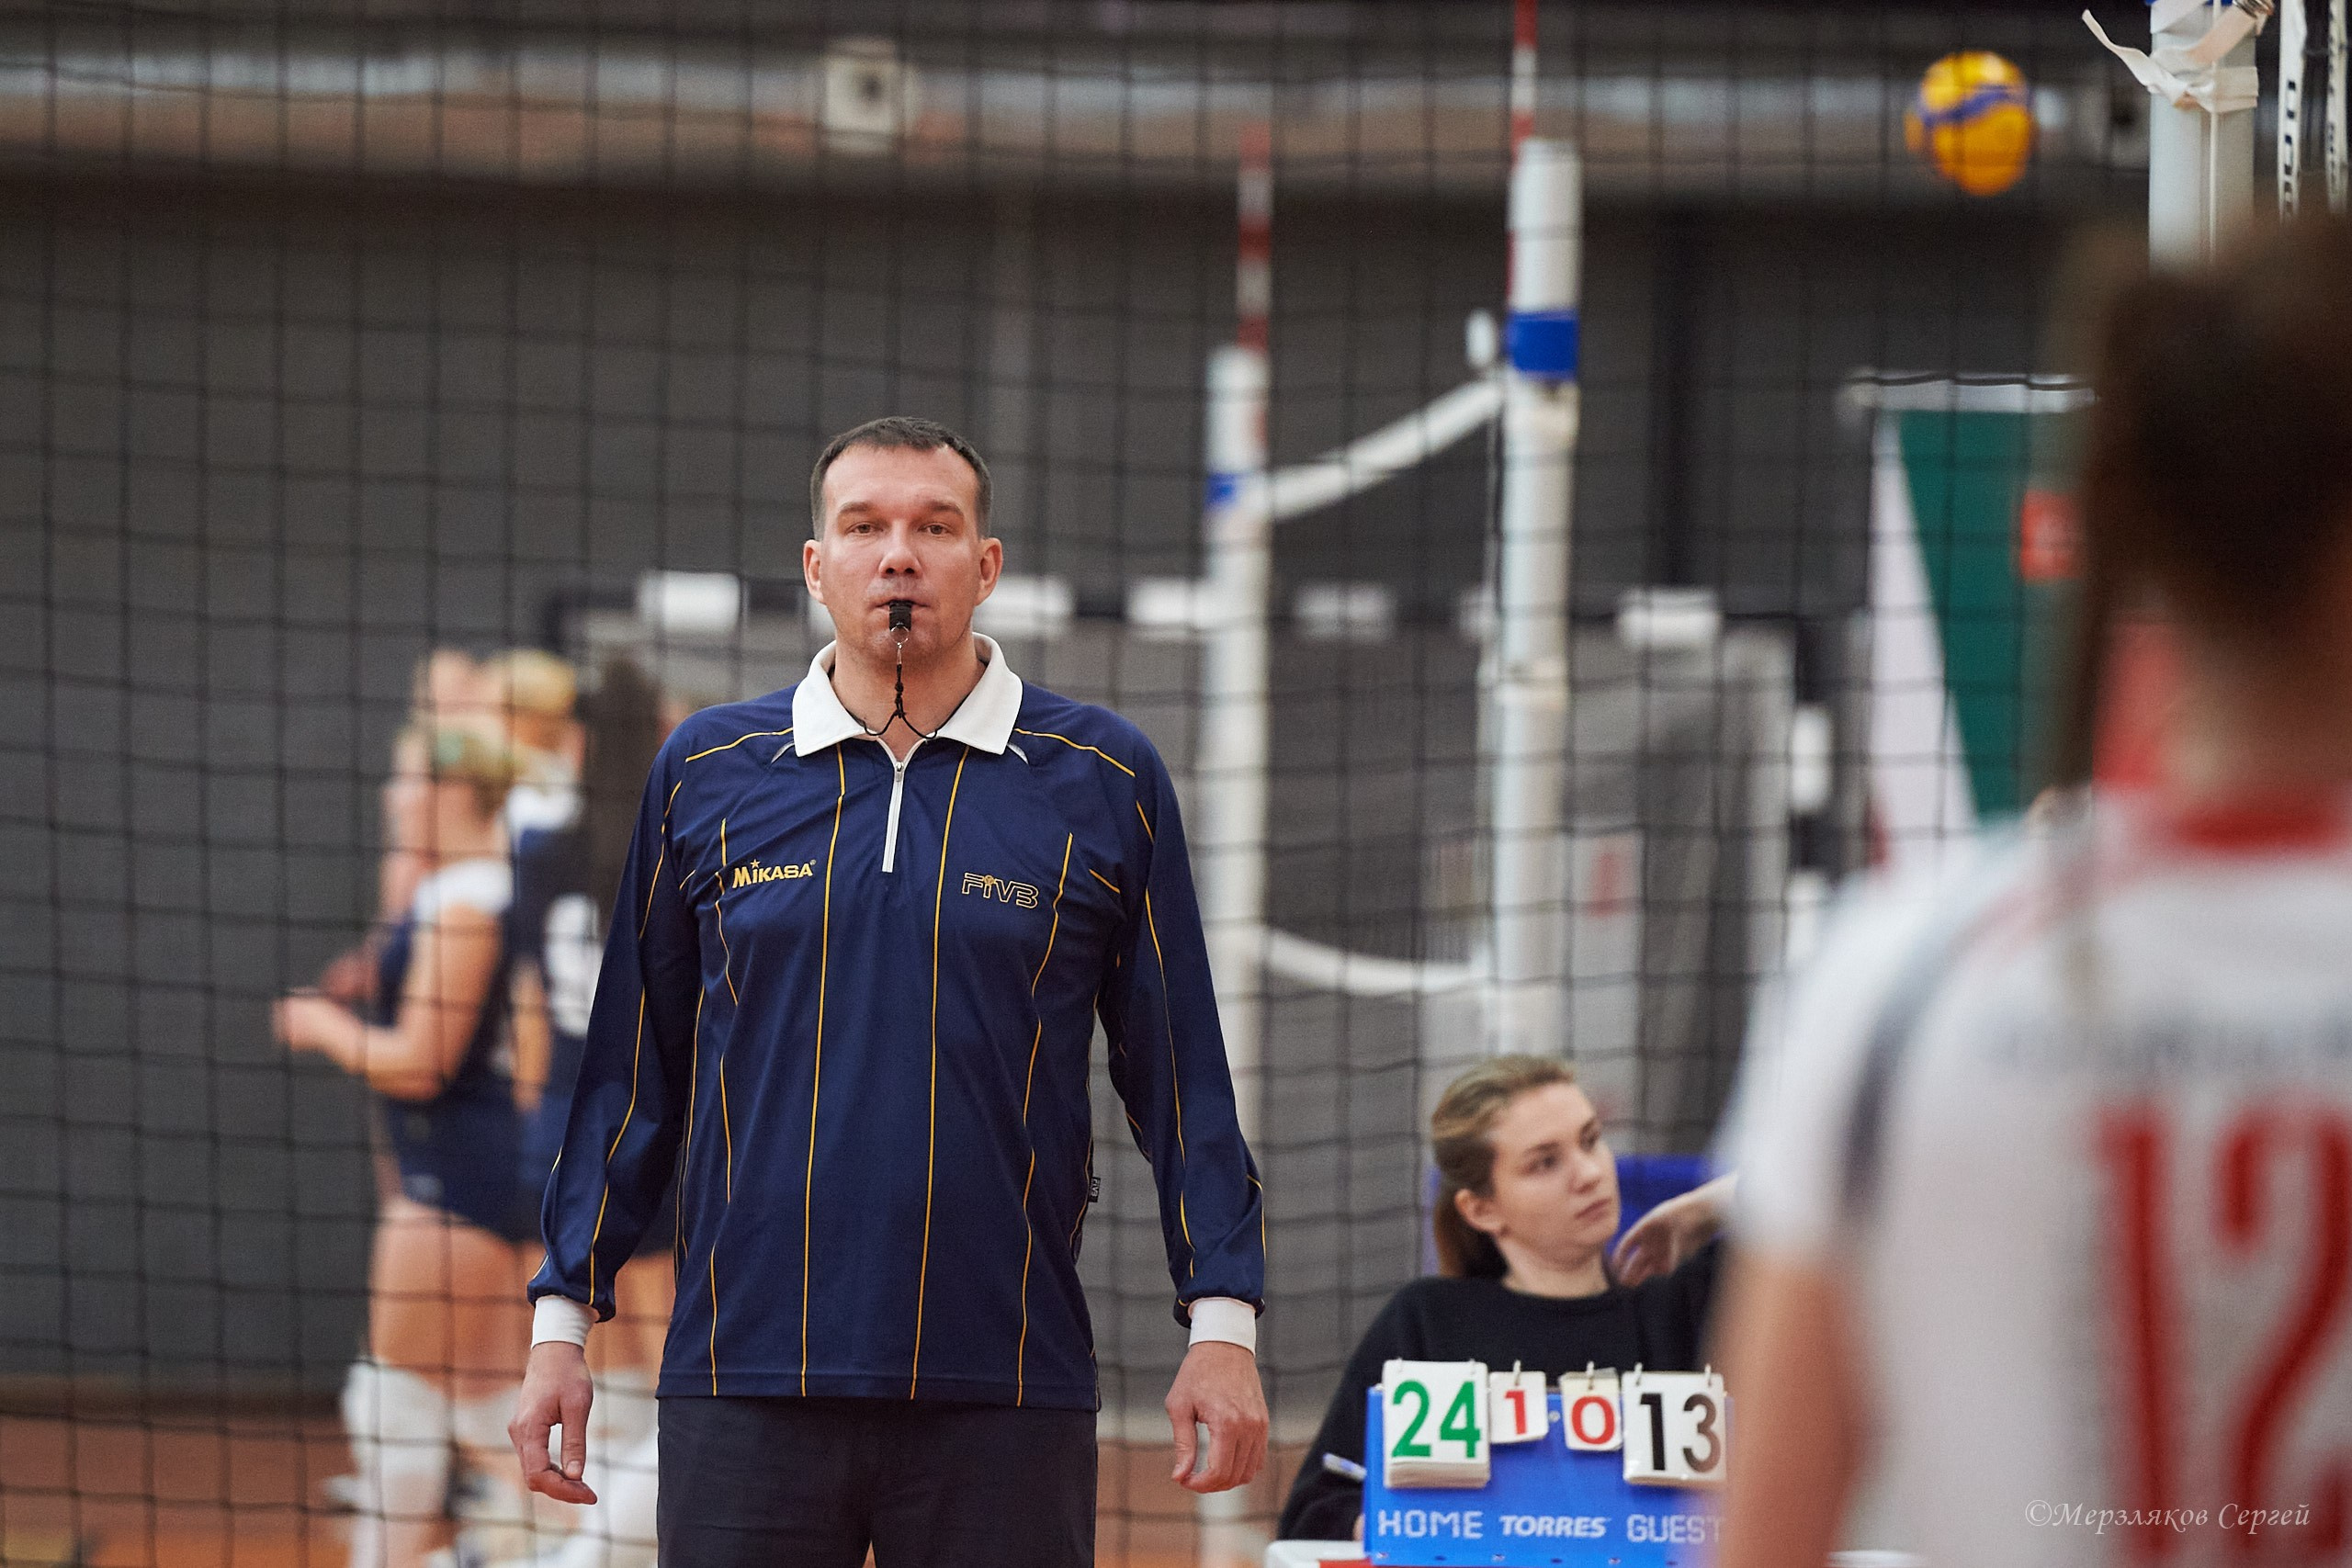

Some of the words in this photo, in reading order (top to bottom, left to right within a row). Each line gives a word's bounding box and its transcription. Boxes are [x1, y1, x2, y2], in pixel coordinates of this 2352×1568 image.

[1391, 1381, 1482, 1459] 24
[1504, 1390, 1527, 1435] 1
[1571, 1395, 1616, 1445] 0
[1640, 1393, 1718, 1473] 13
[1379, 1508, 1484, 1539] HOME
[1499, 1516, 1608, 1538] TORRES
